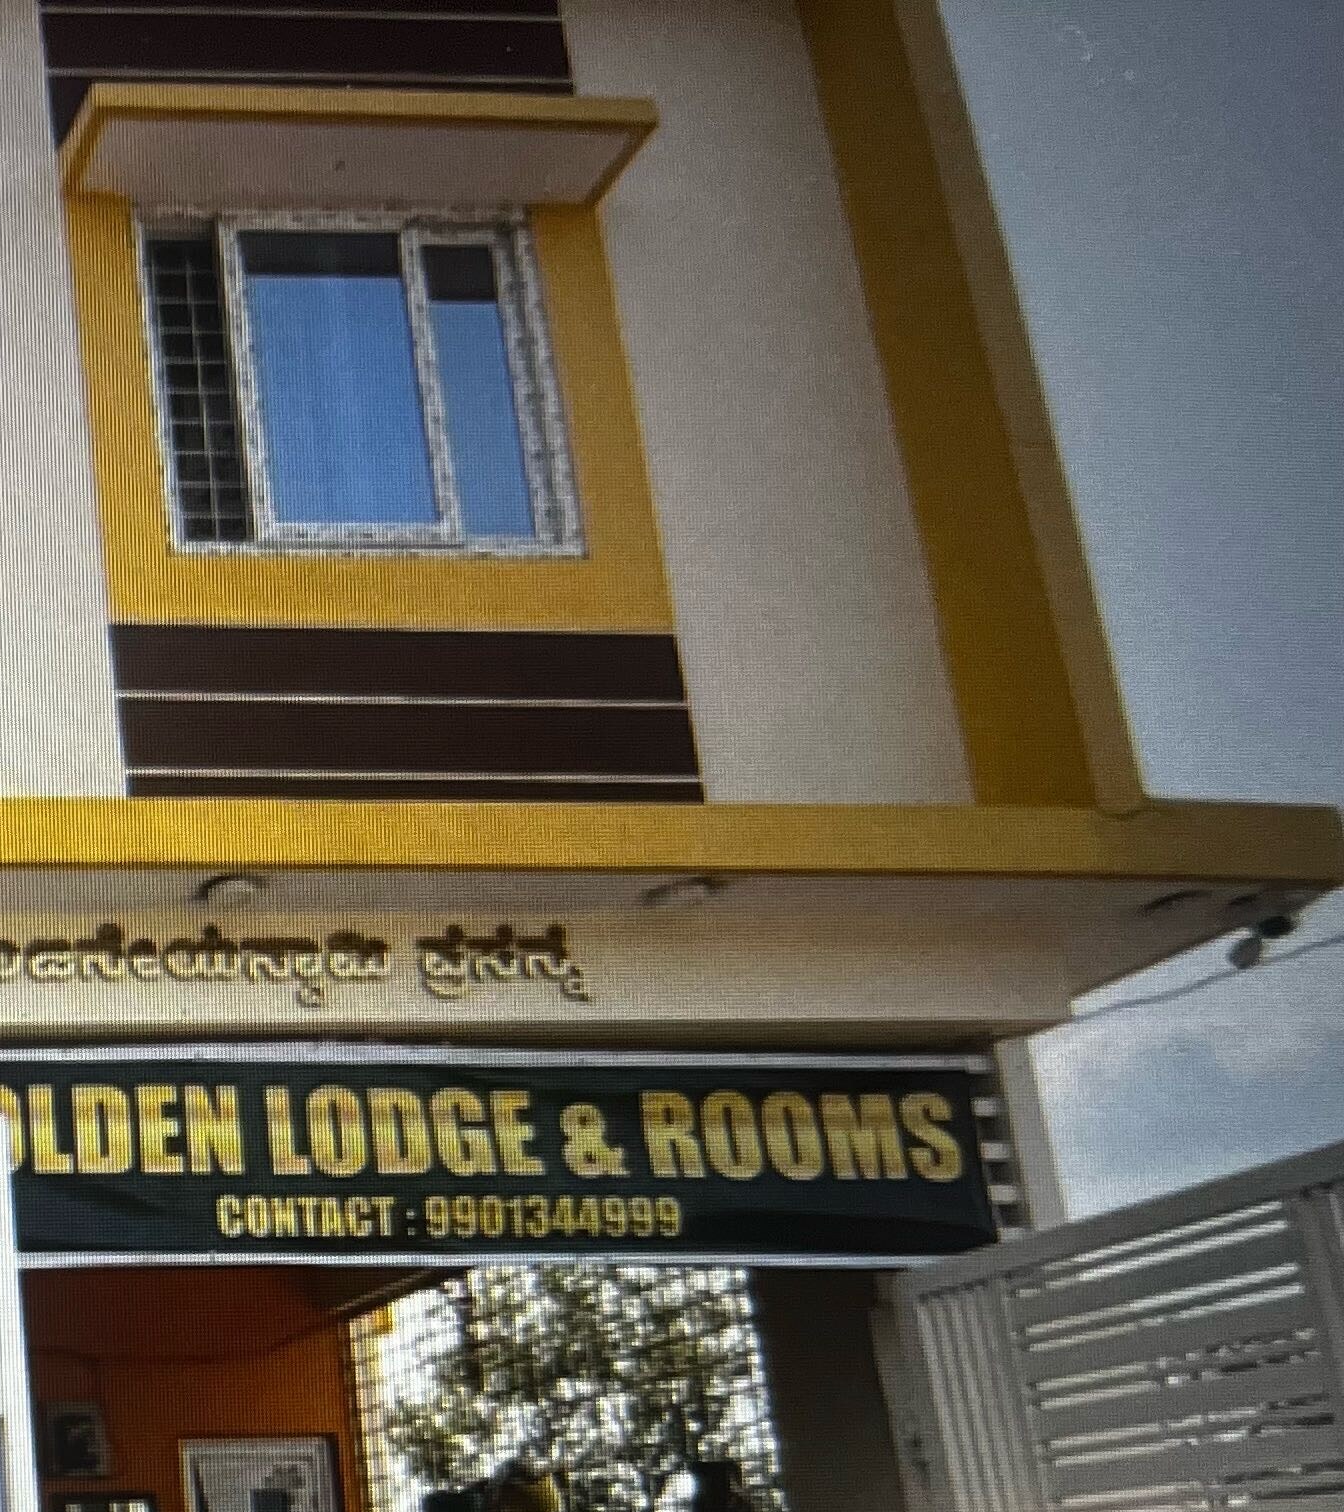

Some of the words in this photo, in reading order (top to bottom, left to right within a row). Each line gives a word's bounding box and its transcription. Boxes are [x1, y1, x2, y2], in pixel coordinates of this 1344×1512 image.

[264, 1084, 546, 1178] LODGE
[559, 1101, 631, 1179] &
[640, 1089, 963, 1183] ROOMS
[215, 1193, 395, 1239] CONTACT
[424, 1194, 682, 1240] 9901344999
